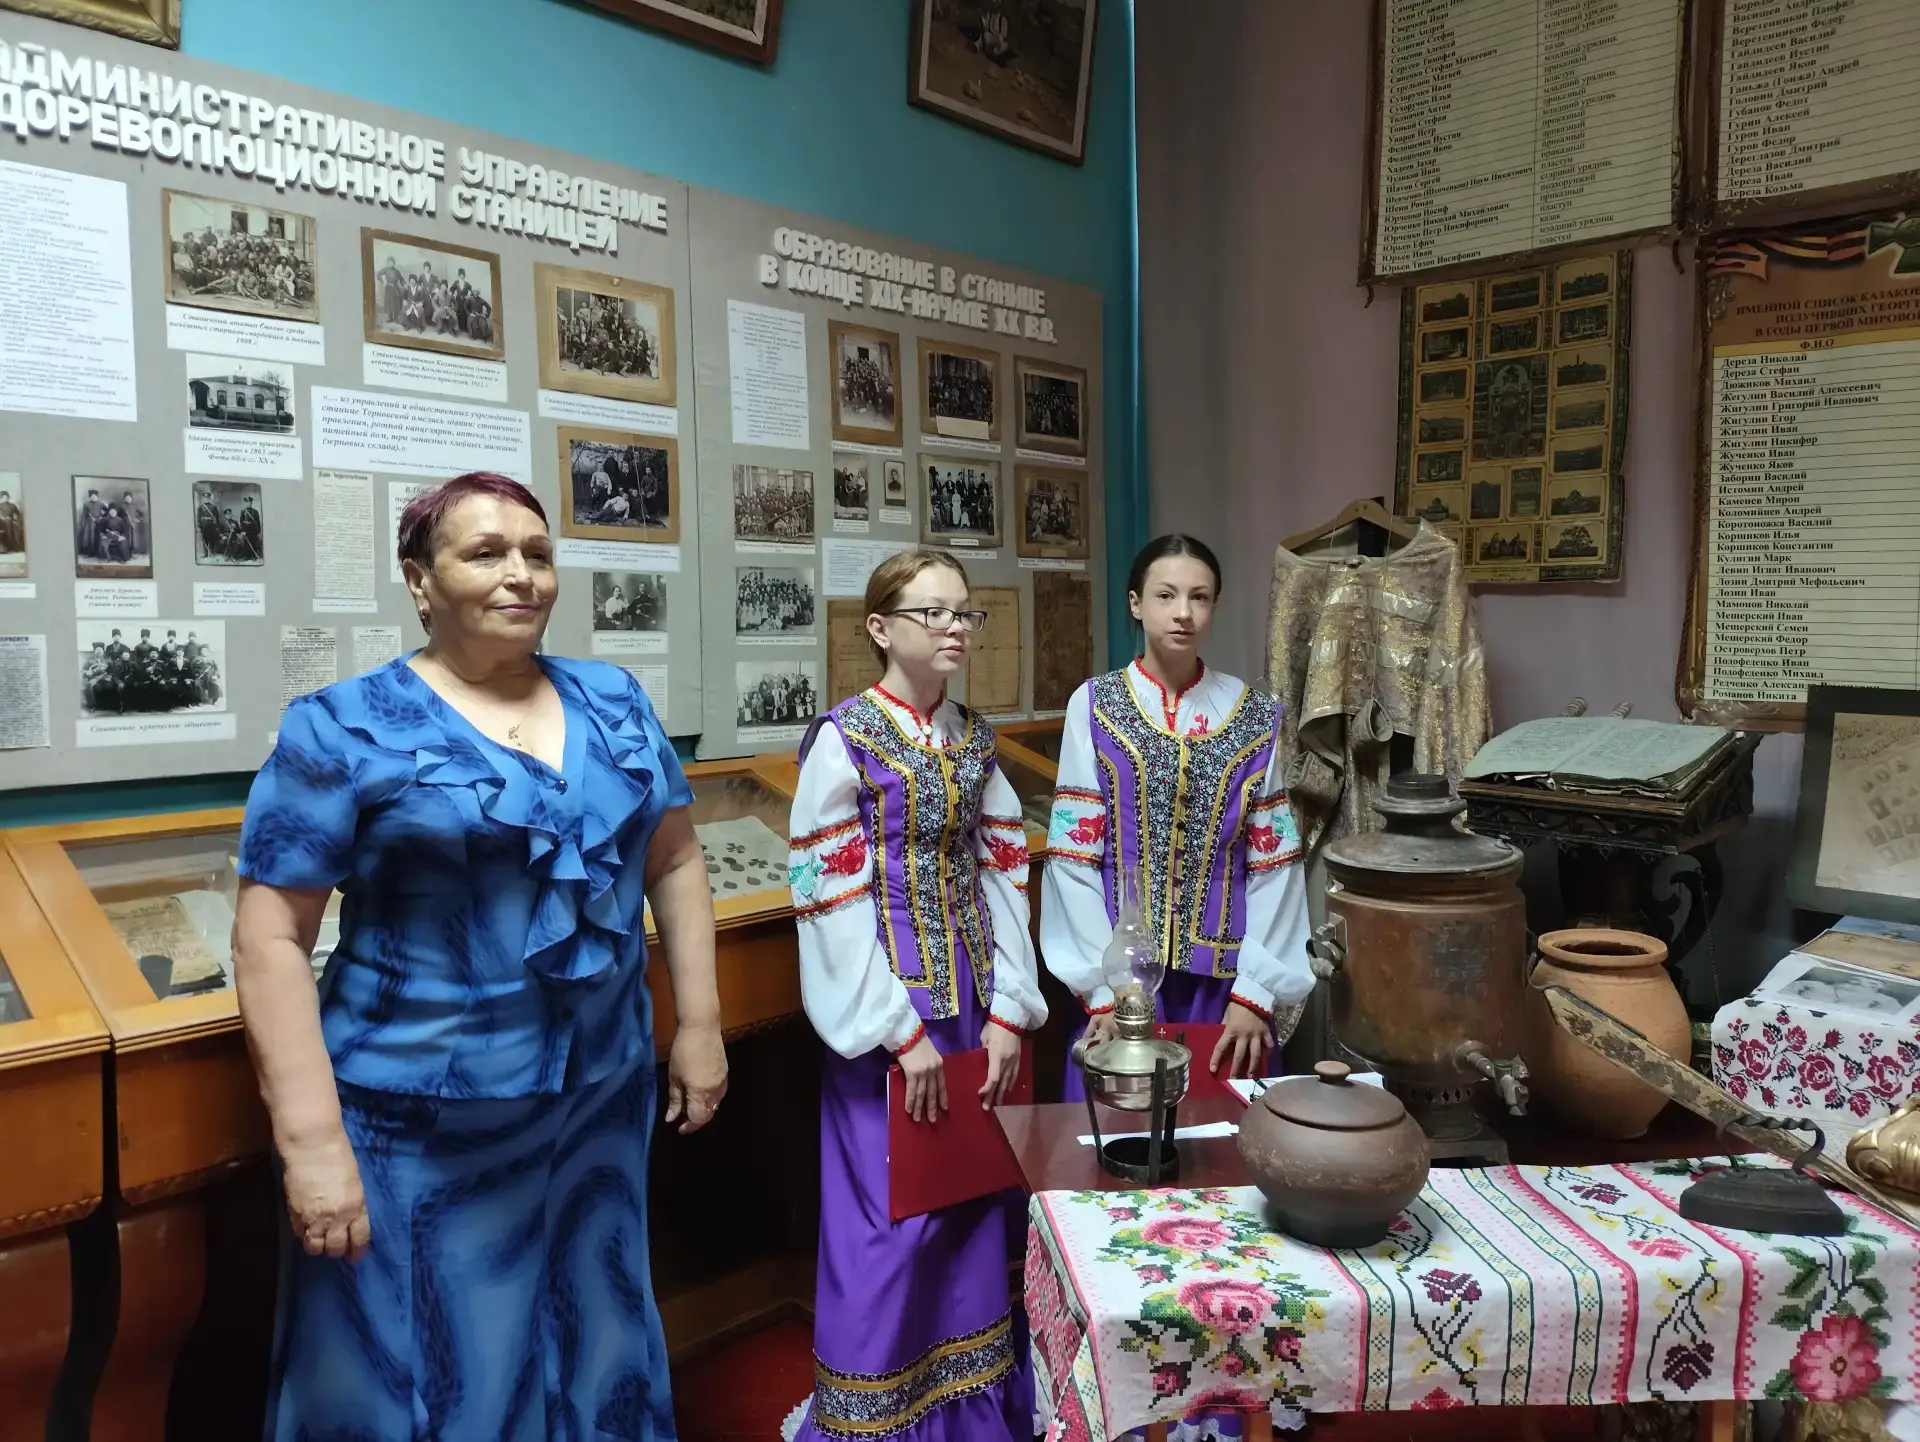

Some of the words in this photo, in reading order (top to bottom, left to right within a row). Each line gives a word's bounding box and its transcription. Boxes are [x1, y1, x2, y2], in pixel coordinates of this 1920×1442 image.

[1728, 104, 1772, 118] Губанов
[1775, 96, 1809, 109] Федот
[1728, 119, 1761, 130] Гурин
[1764, 108, 1810, 124] Алексей
[1727, 131, 1759, 142] Гуров
[1762, 124, 1791, 136] Иван
[1727, 143, 1758, 154] Гуров
[1761, 135, 1796, 149] Федор
[1726, 149, 1786, 166] Дереглазов
[1788, 137, 1841, 155] Дмитрий
[0, 82, 436, 213] ДОРЕВОЛЮЦИОННОЙ
[451, 184, 617, 252] СТАНИЦЕЙ
[1725, 165, 1762, 177] Дереза
[1765, 155, 1813, 171] Василий
[1725, 178, 1762, 188] Дереза
[1765, 171, 1793, 182] Иван
[460, 145, 667, 229] УПРАВЛЕНИЕ
[1725, 188, 1761, 198] Дереза
[1764, 181, 1804, 195] Козьма
[773, 226, 935, 290] ОБРАЗОВАНИЕ
[940, 265, 956, 293] В
[961, 273, 1046, 315] СТАНИЦЕ
[760, 253, 778, 284] В
[786, 260, 863, 306] КОНЦЕ
[1736, 299, 1801, 315] ИМЕННОЙ
[1804, 294, 1858, 309] СПИСОК
[1776, 306, 1867, 324] ПОЛУЧИВШИХ
[1871, 299, 1920, 312] ГЕОРГ
[1766, 325, 1801, 336] ГОДЫ
[1804, 317, 1854, 334] ПЕРВОЙ
[1800, 338, 1834, 350] Ф.И.О
[1721, 358, 1757, 368] Дереза
[1760, 354, 1808, 364] Николай
[1721, 369, 1757, 380] Дереза
[1759, 365, 1800, 376] Стефан
[1721, 379, 1771, 390] Дюжиков
[1773, 377, 1816, 386] Михаил
[1770, 388, 1815, 399] Василий
[1817, 382, 1881, 395] Алексеевич
[351, 396, 400, 410] управлений
[409, 403, 469, 418] общественных
[1721, 403, 1768, 414] Жигулин
[1771, 400, 1821, 412] Григорий
[1823, 395, 1879, 407] Иванович
[321, 405, 360, 415] станице
[362, 408, 409, 421] Терновской
[1720, 415, 1768, 426] Жигулин
[1771, 414, 1796, 424] Егор
[1720, 427, 1768, 437] Жигулин
[1771, 425, 1798, 434] Иван
[1720, 439, 1768, 449] Жигулин
[1770, 435, 1818, 446] Никифор
[1719, 450, 1765, 461] Жученко
[1768, 449, 1796, 458] Иван
[1719, 462, 1765, 472] Жученко
[1768, 460, 1793, 469] Яков
[1718, 474, 1761, 484] Заборин
[1764, 472, 1807, 481] Василий
[1718, 485, 1764, 494] Истомин
[1767, 483, 1804, 494] Андрей
[1718, 497, 1763, 506] Каменев
[1765, 495, 1800, 505] Мирон
[1718, 508, 1781, 518] Коломийцев
[1783, 506, 1822, 516] Андрей
[1717, 519, 1785, 530] Коротоножка
[1788, 518, 1832, 527] Василий
[1717, 532, 1770, 542] Коршиков
[1773, 530, 1800, 539] Илья
[1717, 543, 1770, 553] Коршиков
[1772, 541, 1834, 551] Константин
[1716, 554, 1761, 563] Кулигин
[1763, 553, 1792, 563] Марк
[1716, 566, 1749, 574] Левин
[1752, 565, 1782, 574] Игнат
[1785, 565, 1836, 574] Иванович
[1715, 577, 1748, 586] Лозин
[1750, 577, 1796, 588] Дмитрий
[1799, 577, 1866, 587] Мефодьевич
[1716, 588, 1748, 597] Лозин
[1750, 588, 1776, 597] Иван
[1716, 600, 1763, 608] Мамонов
[1765, 600, 1809, 609] Николай
[1715, 611, 1775, 621] Мещерский
[1777, 612, 1803, 621] Иван
[1715, 622, 1774, 633] Мещерский
[1776, 624, 1809, 633] Семен
[1714, 633, 1773, 644] Мещерский
[1775, 634, 1808, 645] Федор
[1713, 645, 1777, 656] Островерхов
[1779, 646, 1806, 657] Петр
[1782, 659, 1810, 667] Иван
[1781, 669, 1824, 679] Михаил
[1712, 689, 1754, 699] Романов
[1757, 691, 1797, 700] Никита
